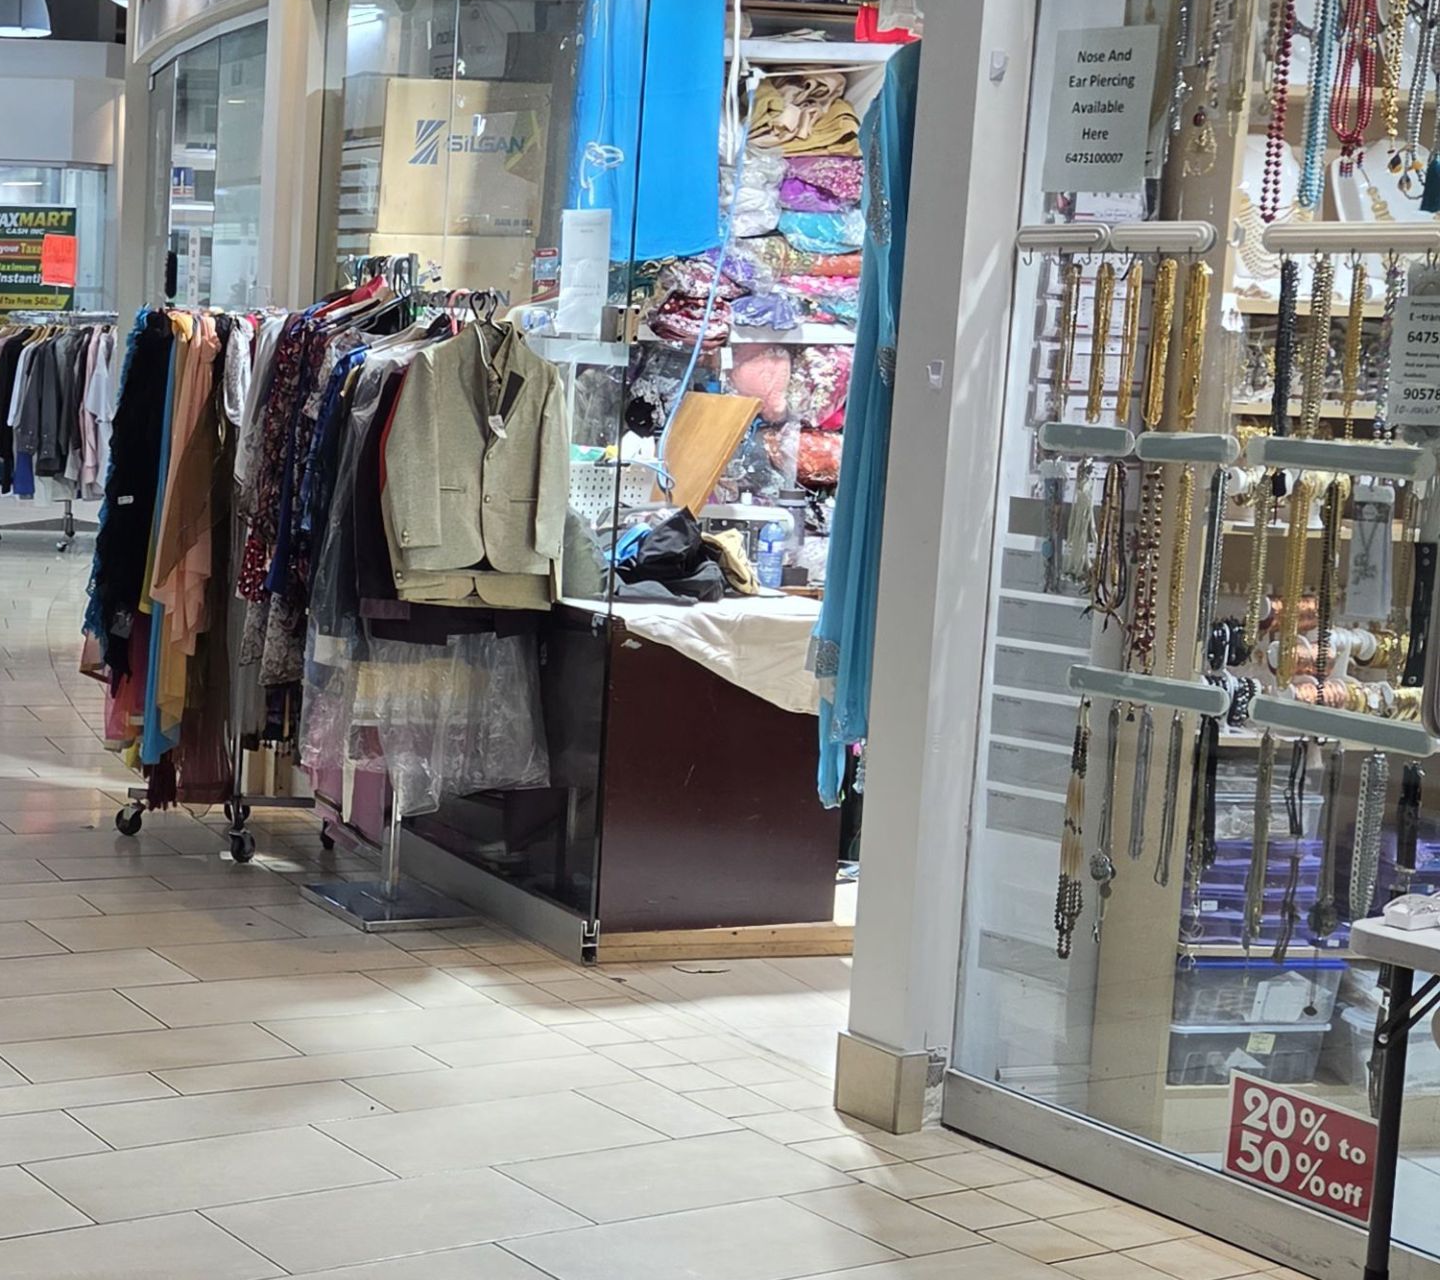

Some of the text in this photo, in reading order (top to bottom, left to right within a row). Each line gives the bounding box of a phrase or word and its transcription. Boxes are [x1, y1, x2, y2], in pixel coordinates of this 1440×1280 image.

[1077, 48, 1133, 63] Nose And
[1068, 73, 1135, 89] Ear Piercing
[1072, 100, 1124, 114] Available
[1082, 128, 1109, 140] Here
[1065, 152, 1123, 164] 6475100007
[0, 245, 19, 255] your
[1407, 331, 1440, 343] 6475
[1403, 388, 1440, 400] 90578
[1241, 1087, 1367, 1165] 20% to
[1235, 1129, 1363, 1208] 50% off
